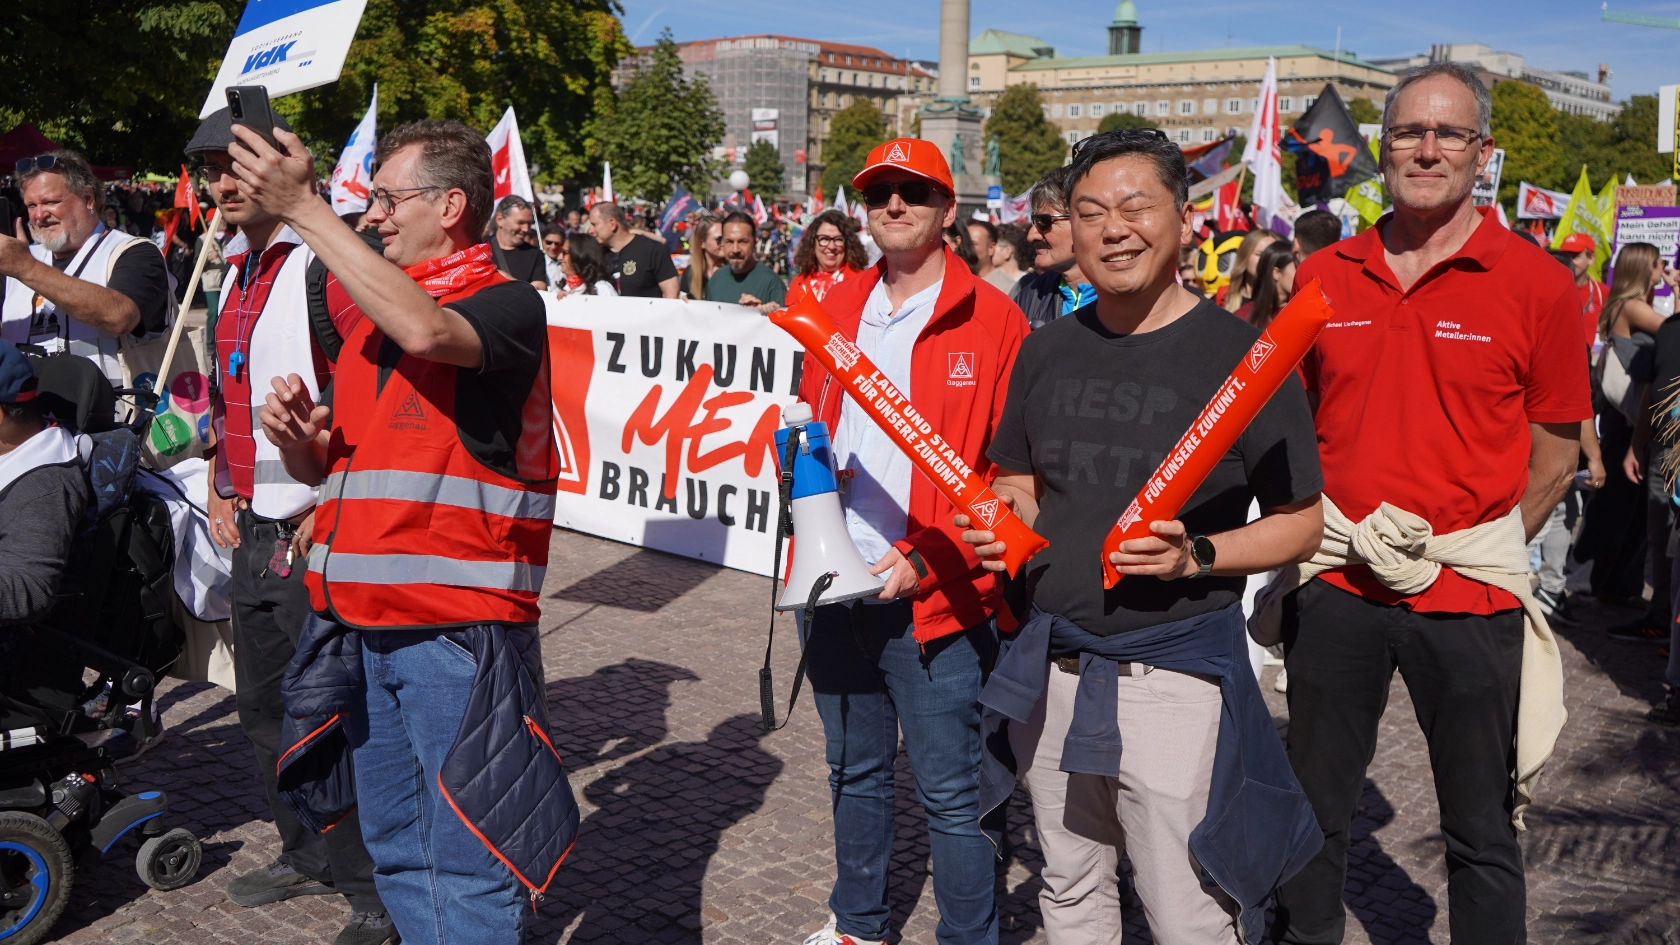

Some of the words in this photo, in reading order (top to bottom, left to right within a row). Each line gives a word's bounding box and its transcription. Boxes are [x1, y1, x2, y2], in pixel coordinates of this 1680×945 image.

[241, 39, 298, 75] VdK
[1619, 232, 1645, 240] kann
[1648, 232, 1675, 240] nicht
[1620, 221, 1644, 229] Mein
[1647, 220, 1678, 229] Gehalt
[1435, 330, 1492, 342] Metaller:innen
[1436, 320, 1461, 330] Aktive
[834, 333, 859, 358] ZUKUNFT
[946, 379, 976, 388] Gaggenau
[1047, 378, 1178, 425] RESP
[852, 373, 879, 403] FÜR
[873, 396, 919, 445] UNSERE
[912, 439, 967, 497] ZUKUNFT.
[869, 369, 906, 406] LAUT
[902, 404, 932, 435] UND
[929, 433, 974, 479] STARK
[1144, 476, 1167, 505] FÜR
[1161, 432, 1202, 481] UNSERE
[1196, 376, 1247, 438] ZUKUNFT.
